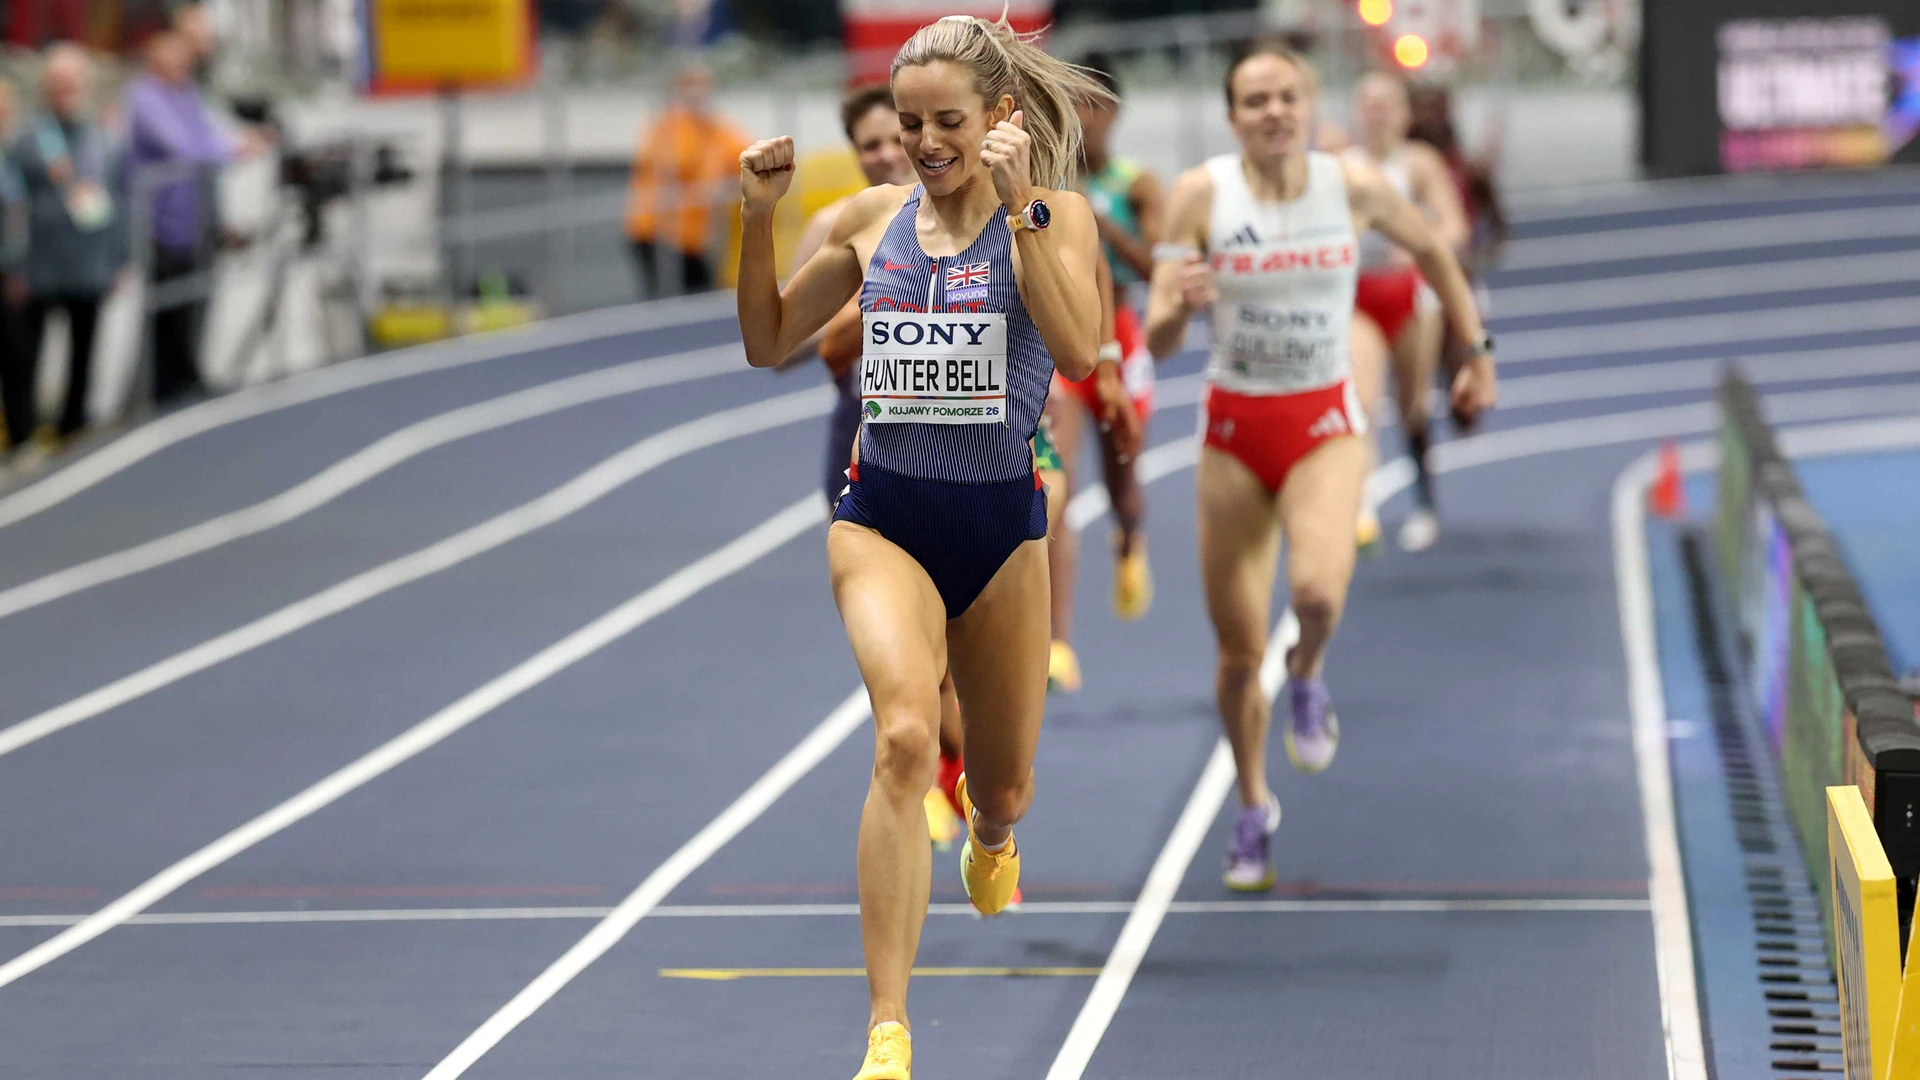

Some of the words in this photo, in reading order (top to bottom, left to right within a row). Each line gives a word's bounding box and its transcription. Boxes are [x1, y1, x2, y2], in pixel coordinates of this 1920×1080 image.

[1211, 245, 1354, 273] FRANCE
[947, 288, 988, 301] Novuna
[871, 321, 991, 346] SONY
[863, 359, 939, 392] HUNTER
[946, 360, 1000, 392] BELL
[888, 406, 931, 415] KUJAWY
[933, 407, 983, 416] POMORZE
[986, 406, 999, 415] 26
